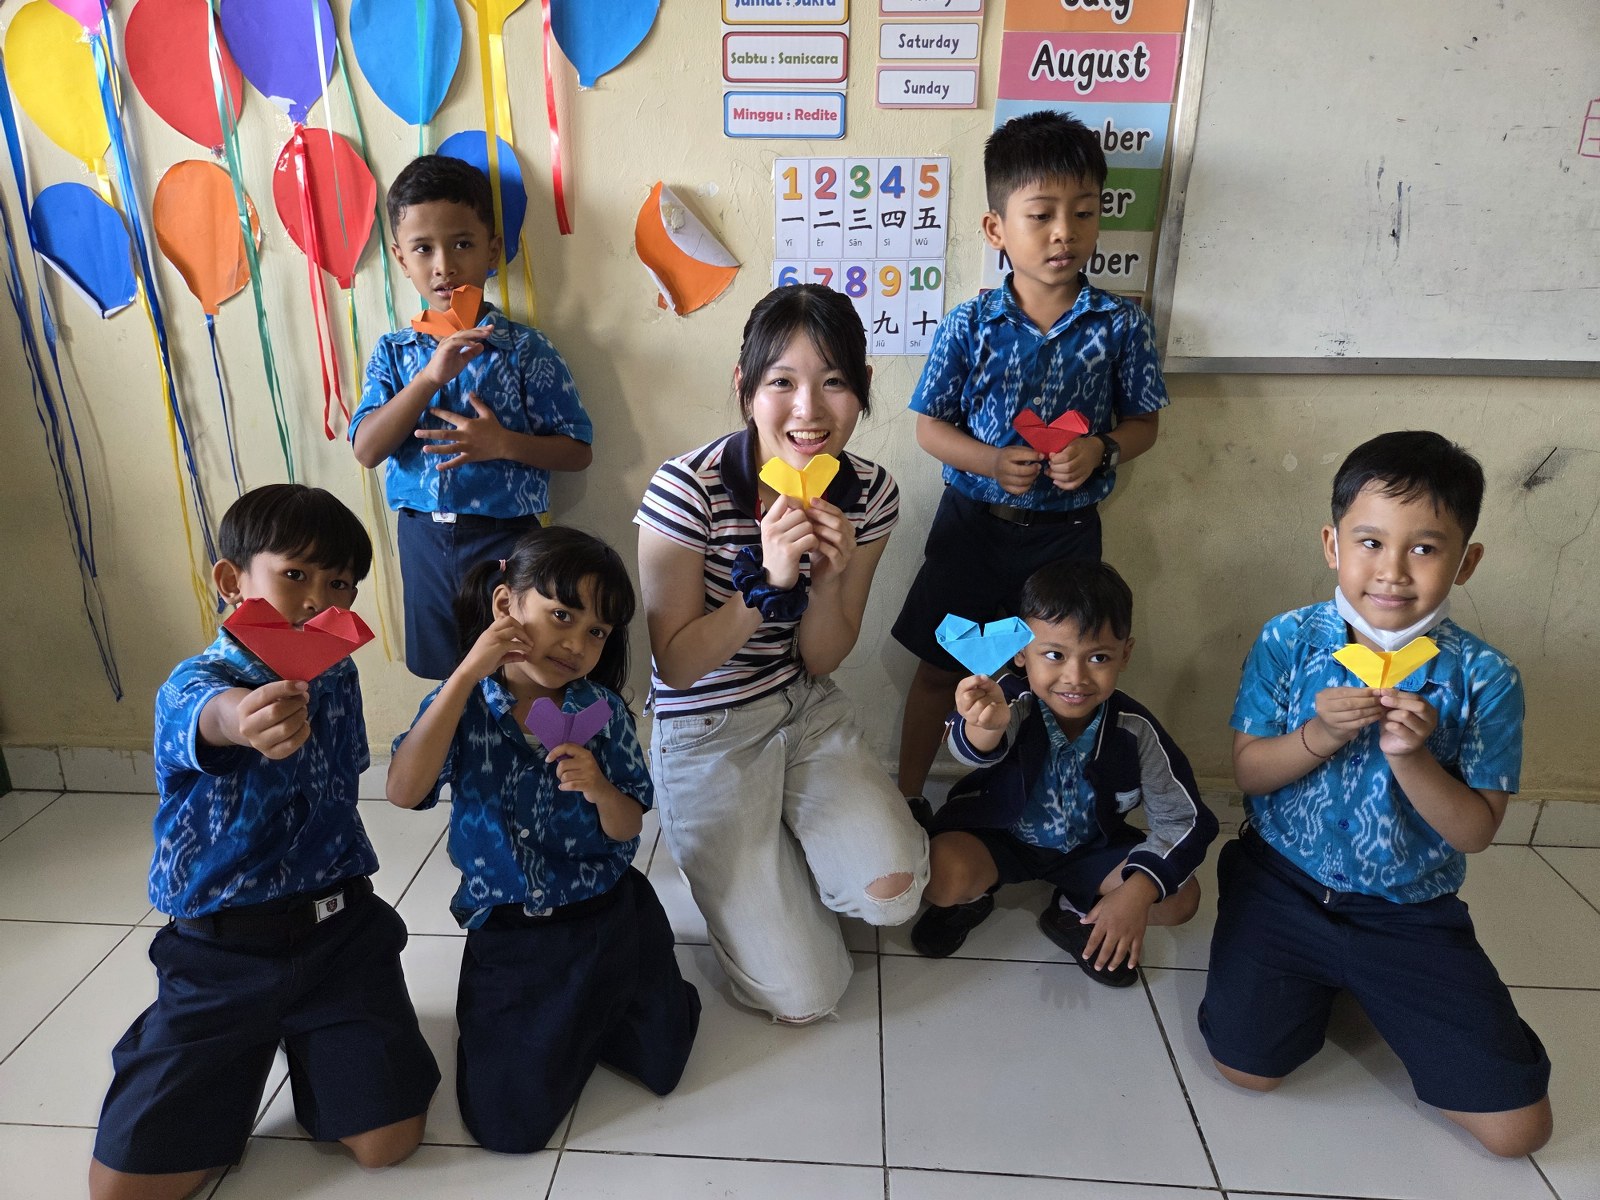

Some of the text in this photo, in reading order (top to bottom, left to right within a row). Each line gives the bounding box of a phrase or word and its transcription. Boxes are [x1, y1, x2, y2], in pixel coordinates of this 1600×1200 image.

[898, 33, 960, 55] Saturday
[731, 52, 768, 64] Sabtu
[778, 52, 839, 65] Saniscara
[1031, 43, 1147, 91] August
[903, 79, 950, 100] Sunday
[733, 107, 783, 122] Minggu
[794, 108, 838, 121] Redite
[782, 164, 940, 200] 1 2 3 4 5
[813, 210, 841, 229] 二
[848, 208, 872, 231] 三
[881, 210, 907, 228] 四
[913, 207, 941, 230] 五
[848, 238, 862, 246] Sān
[778, 265, 942, 298] 6 7 8 9 10
[873, 310, 938, 336] 九 十
